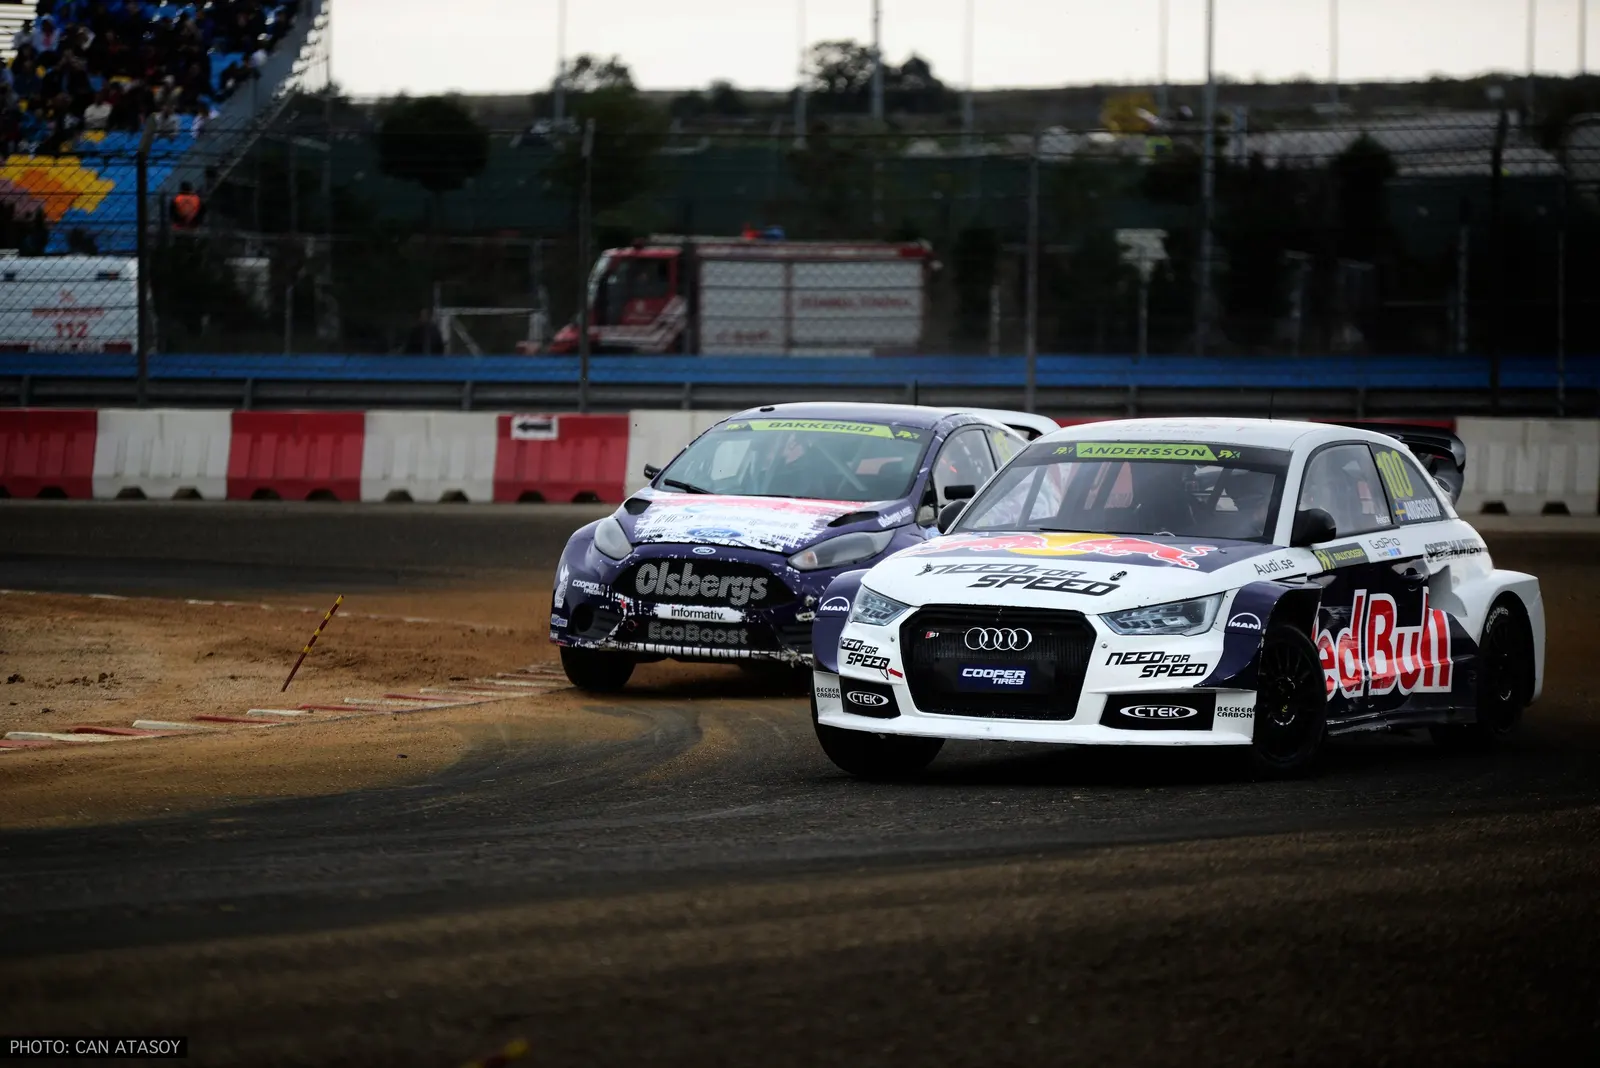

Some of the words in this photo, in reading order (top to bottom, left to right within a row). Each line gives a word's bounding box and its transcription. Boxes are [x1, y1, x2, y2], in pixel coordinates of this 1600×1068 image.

[768, 421, 875, 433] BAKKERUD
[1081, 446, 1206, 457] ANDERSSON
[1375, 450, 1414, 500] 100
[1369, 537, 1401, 550] GoPro
[1024, 567, 1088, 578] FOR
[1253, 557, 1295, 576] Audi.se
[572, 579, 600, 590] COOPER
[635, 561, 768, 606] Olsbergs
[966, 573, 1121, 597] SPEED
[821, 604, 850, 612] MAN
[1229, 621, 1261, 630] MAN
[648, 621, 749, 644] EcoBoost
[860, 643, 879, 655] FOR
[846, 652, 890, 670] SPEED
[1105, 651, 1165, 666] NEED
[1162, 654, 1191, 663] FOR
[962, 668, 1026, 679] COOPER
[1138, 663, 1208, 678] SPEED
[992, 677, 1025, 685] TIRES
[816, 686, 840, 694] BECKER
[852, 692, 877, 705] CTEK
[1134, 707, 1180, 718] CTEK
[1217, 711, 1254, 719] CARBON
